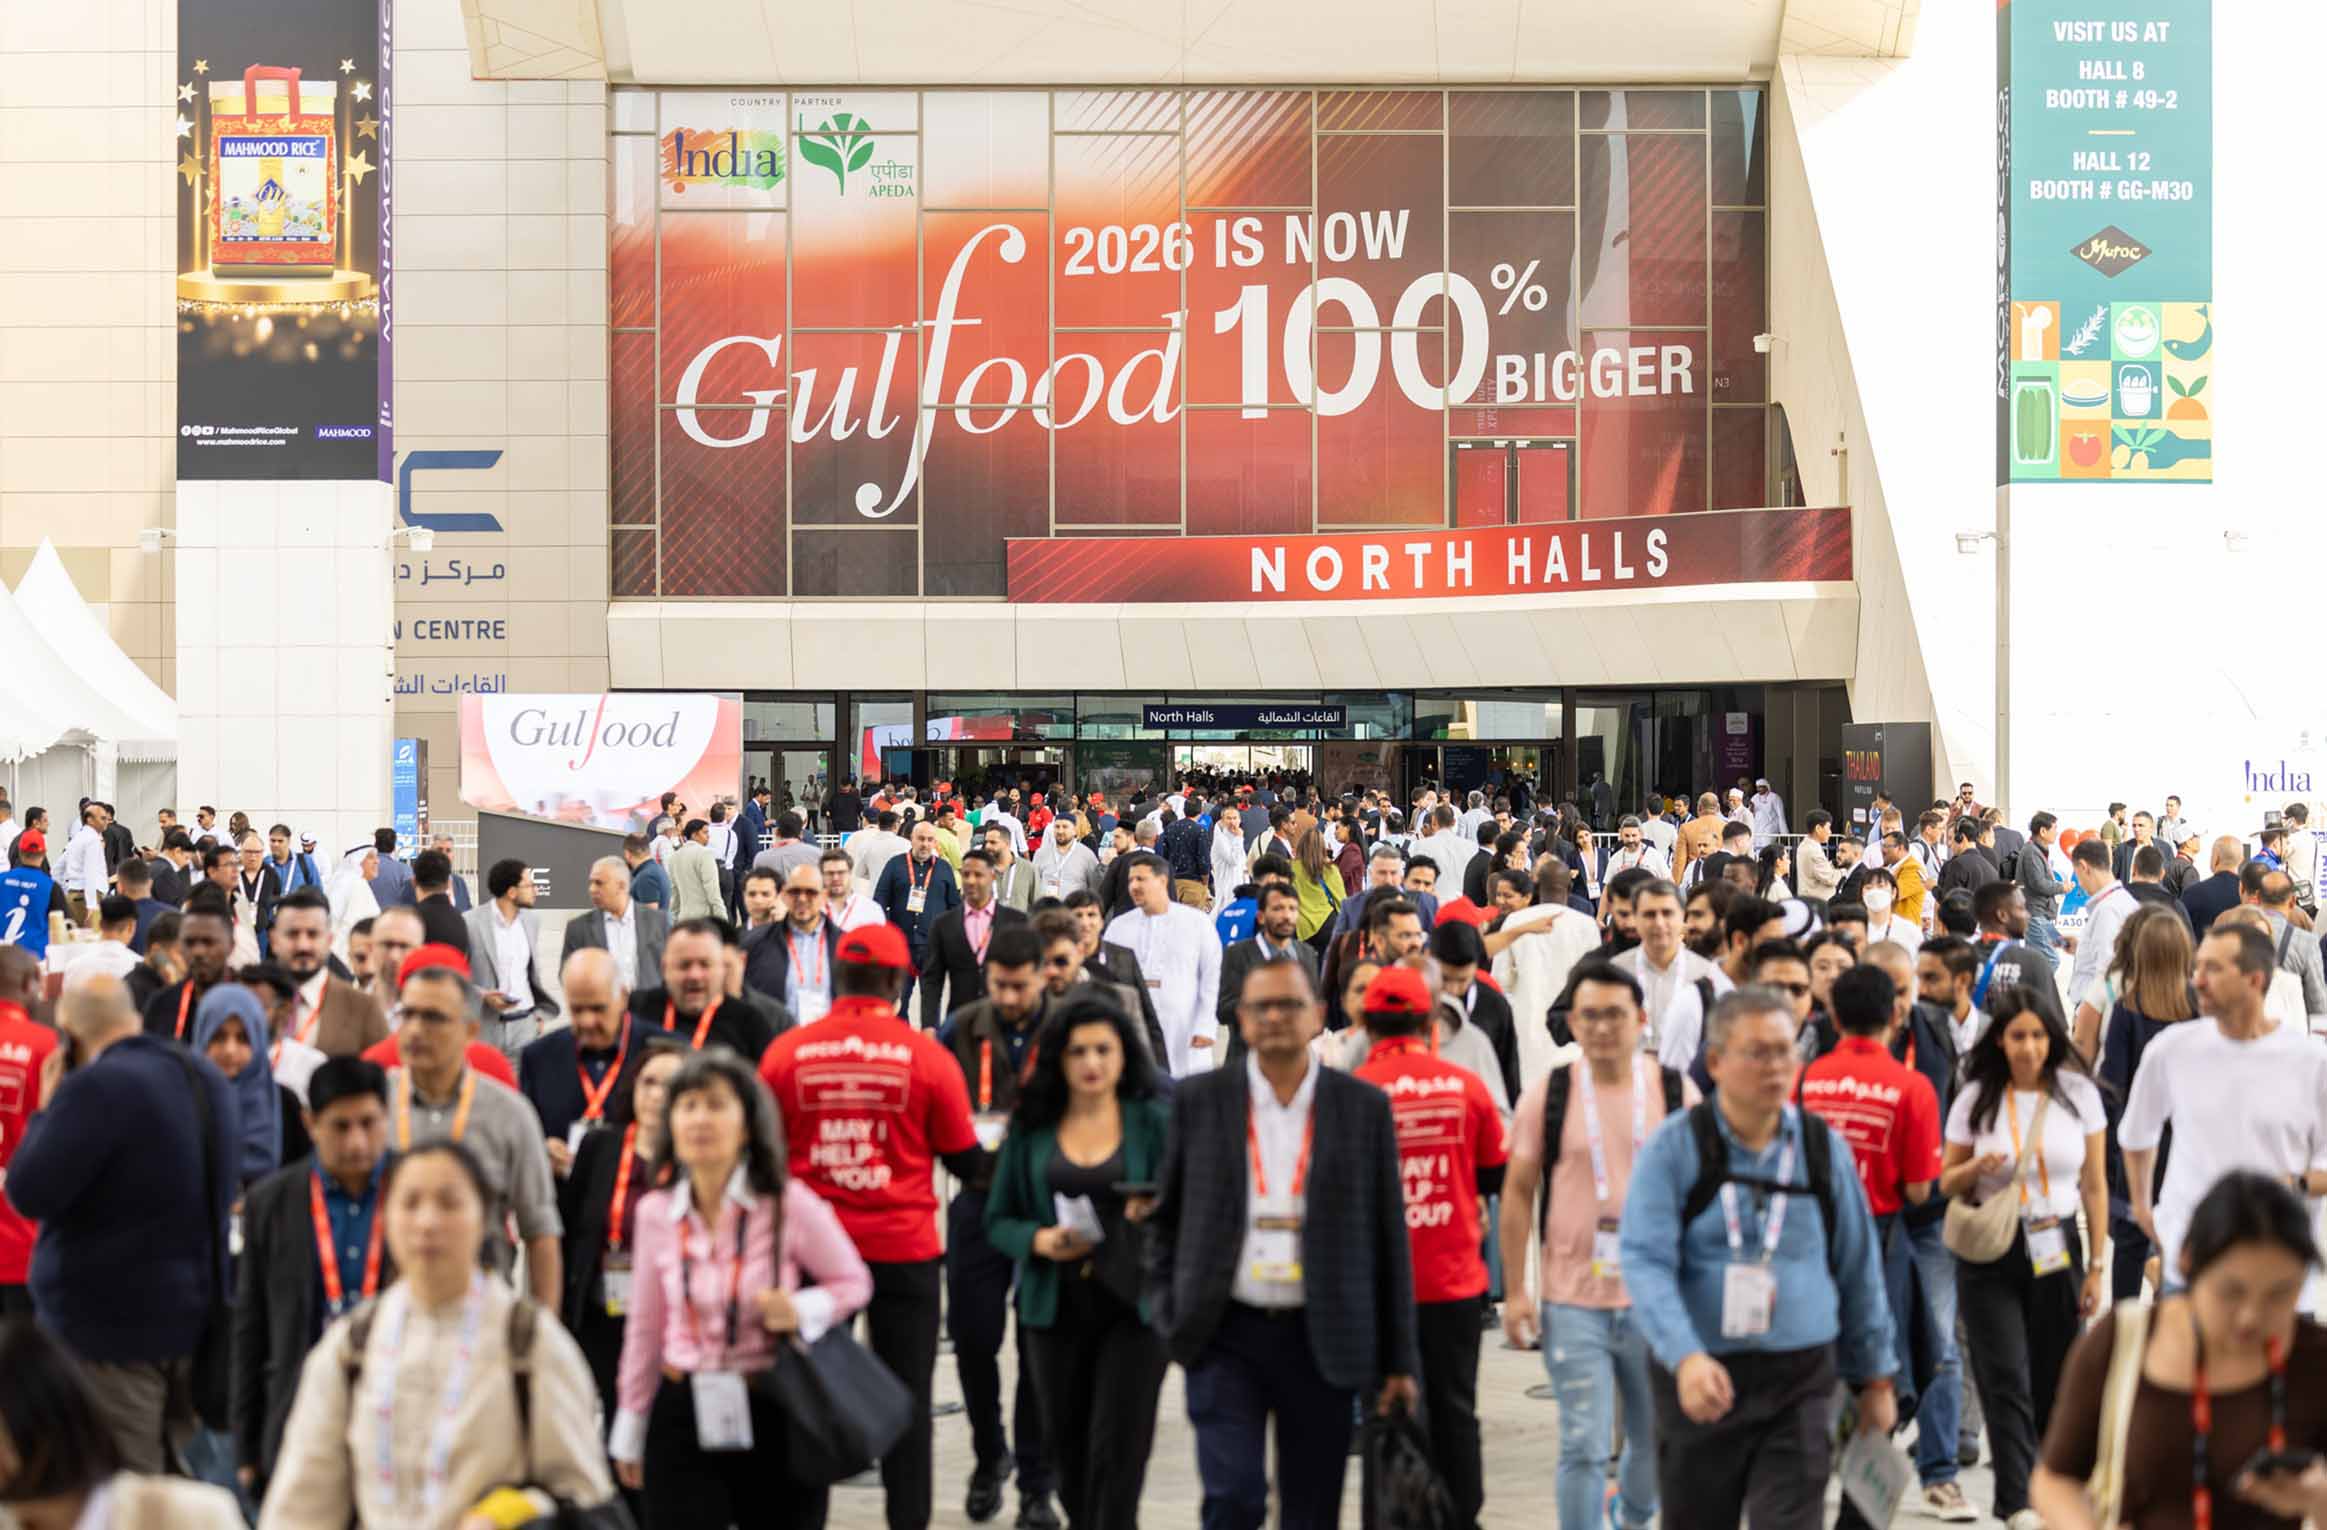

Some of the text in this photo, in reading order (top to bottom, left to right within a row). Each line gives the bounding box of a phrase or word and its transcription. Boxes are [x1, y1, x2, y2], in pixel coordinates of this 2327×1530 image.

[2054, 22, 2170, 41] VISIT US AT
[2080, 61, 2144, 80] HALL 8
[731, 98, 842, 106] COUNTRY PARTNER
[2046, 90, 2178, 109] BOOTH # 49-2
[224, 141, 318, 156] MAHMOOD RICE
[2073, 152, 2151, 170] HALL 12
[382, 0, 391, 342] MAHMOOD RIC
[869, 160, 914, 183] एपीडा
[868, 185, 914, 198] APEDA
[2030, 181, 2193, 199] BOOTH # GG-M30
[1063, 209, 1410, 276] 2026 IS NOW
[675, 223, 1189, 518] Gulfood
[1495, 343, 1694, 404] BIGGER
[1715, 378, 1730, 388] N3
[318, 427, 371, 438] MAHMOOD
[1251, 528, 1669, 593] NORTH HALLS
[420, 560, 506, 586] مركز
[413, 620, 506, 640] CENTRE
[1149, 711, 1215, 723] North Halls
[1257, 711, 1341, 724] القاعات الشمالية
[509, 693, 680, 770] Gulfood
[1401, 1154, 1434, 1178] AY
[1406, 1202, 1454, 1228] OU?
